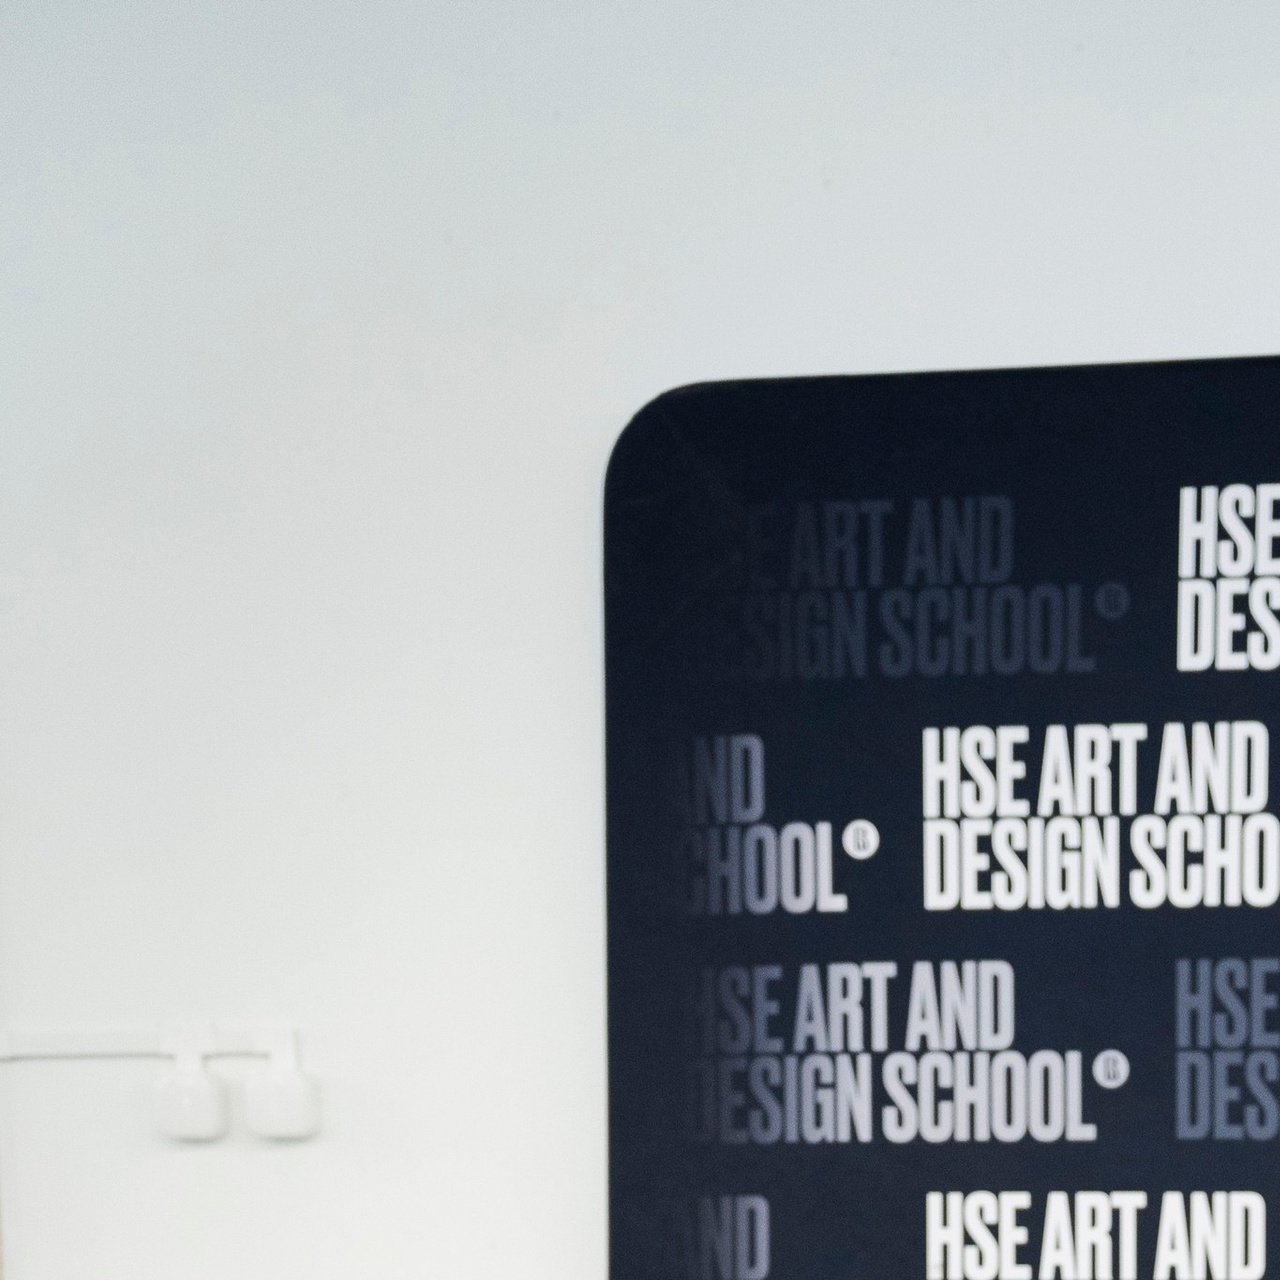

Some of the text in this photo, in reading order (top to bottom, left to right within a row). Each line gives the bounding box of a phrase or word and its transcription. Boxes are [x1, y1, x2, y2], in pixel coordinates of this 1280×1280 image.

[904, 494, 1015, 587] AND
[879, 583, 1097, 678] SCHOOL
[695, 734, 766, 825] ND
[922, 721, 1271, 819] HSE ART AND
[706, 820, 849, 914] HOOL
[922, 815, 1121, 912] DESIGN
[794, 961, 898, 1054] ART
[904, 958, 1017, 1053] AND
[882, 1049, 1098, 1144] SCHOOL
